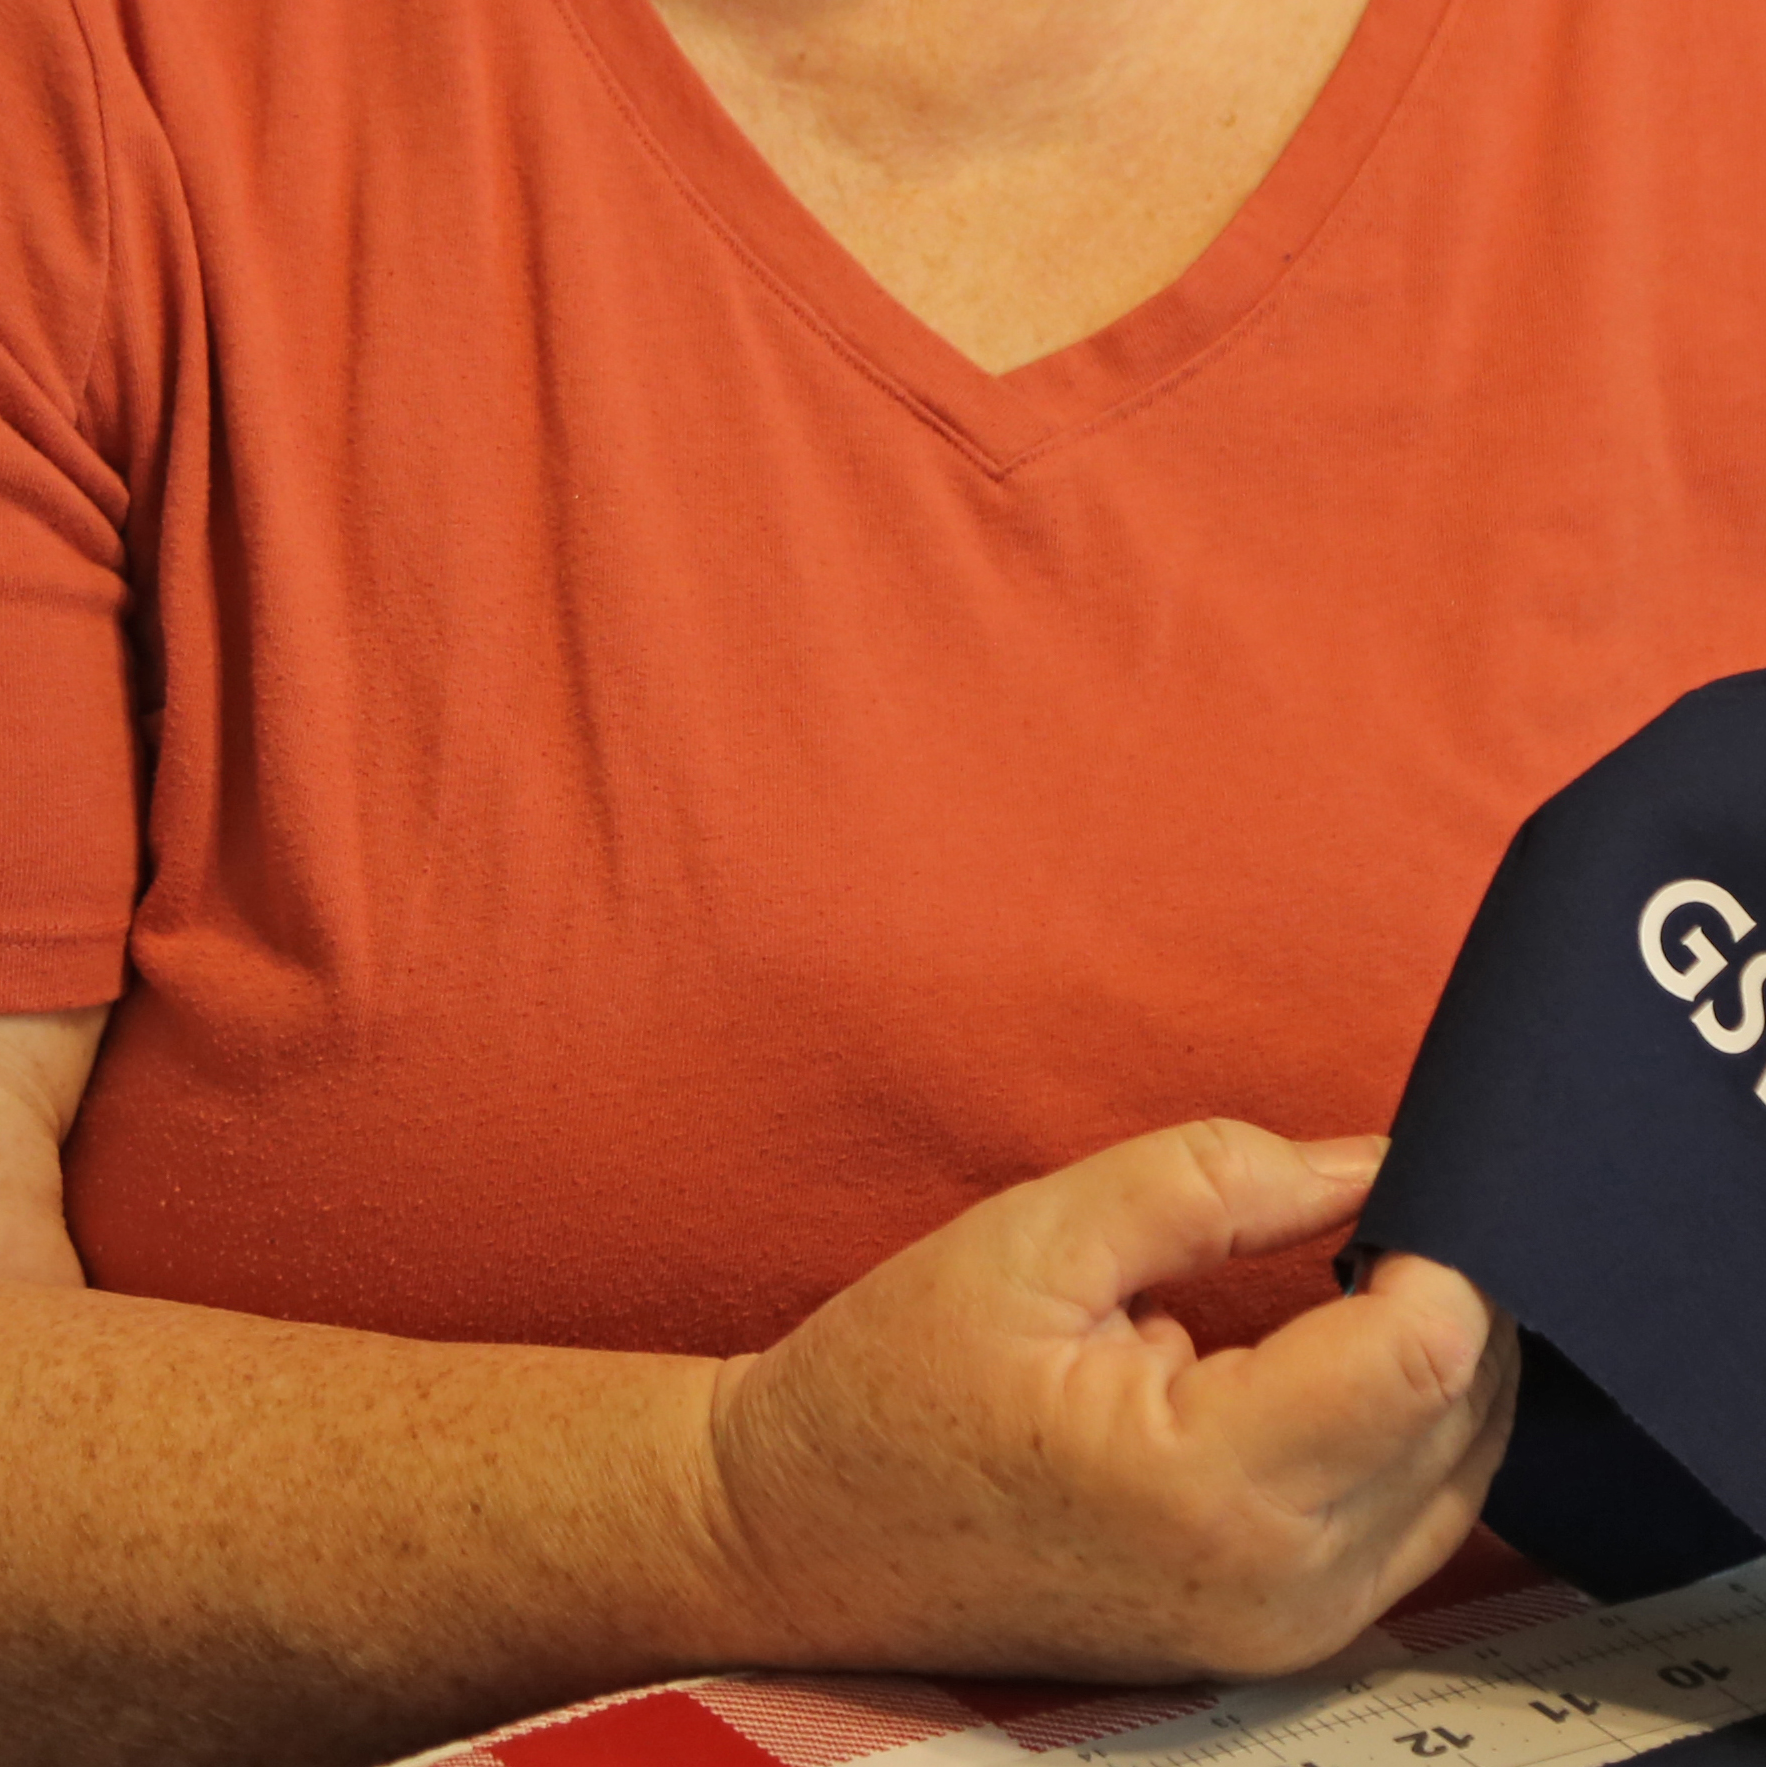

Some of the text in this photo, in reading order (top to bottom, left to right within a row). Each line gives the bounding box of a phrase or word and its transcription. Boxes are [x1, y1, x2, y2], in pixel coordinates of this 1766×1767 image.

[1657, 1658, 1732, 1690] 10
[1528, 1692, 1601, 1724] 11
[1392, 1725, 1476, 1759] 12
